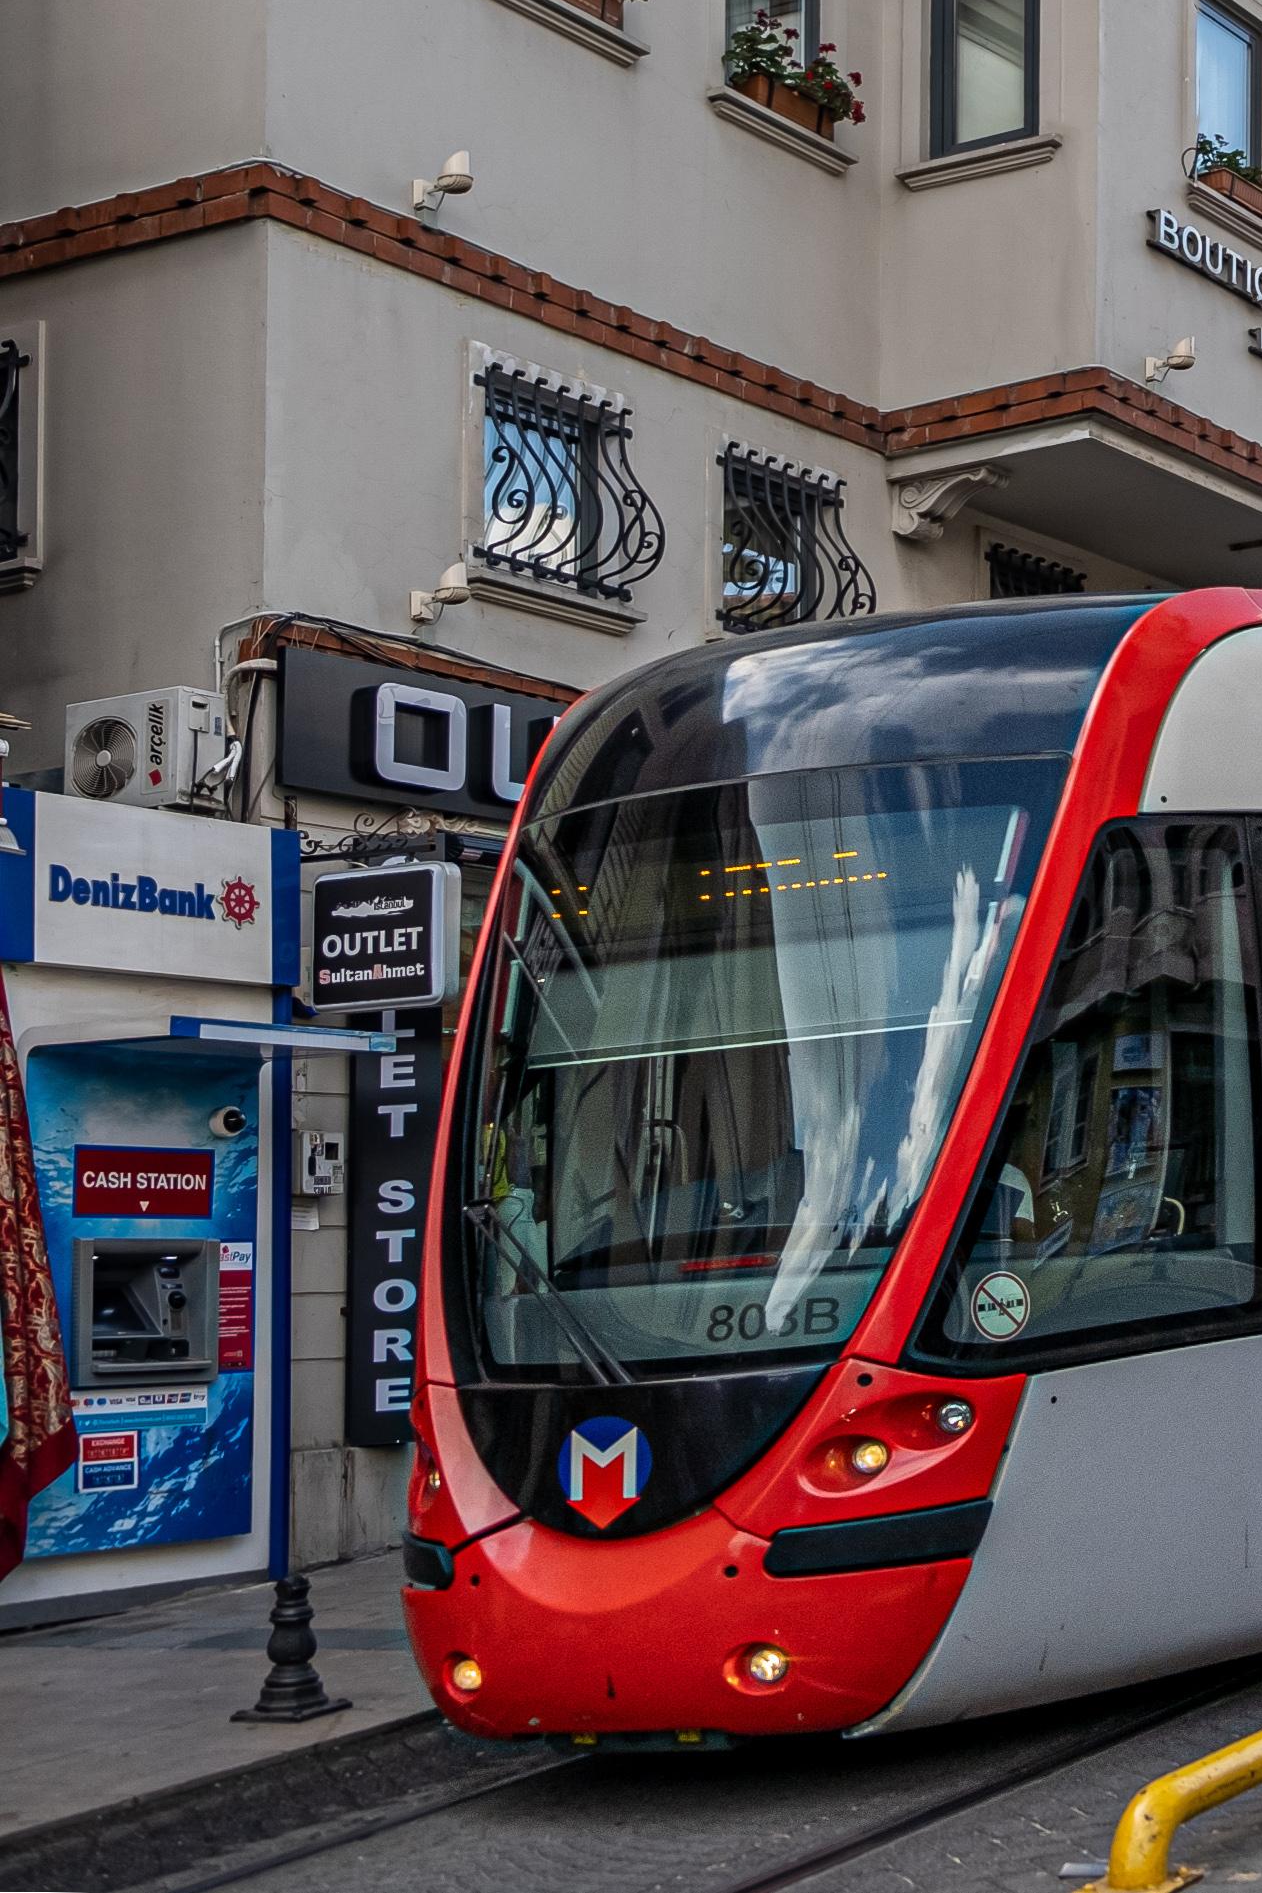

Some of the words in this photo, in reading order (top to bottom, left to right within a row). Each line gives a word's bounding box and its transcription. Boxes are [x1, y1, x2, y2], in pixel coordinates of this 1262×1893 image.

[148, 703, 166, 766] arçelik
[49, 864, 216, 920] DenizBank
[322, 926, 424, 958] OUTLET
[319, 963, 425, 985] SultanAhmet
[82, 1170, 132, 1189] CASH
[136, 1172, 207, 1190] STATION
[373, 1179, 417, 1412] STORE
[706, 1297, 840, 1342] 803B
